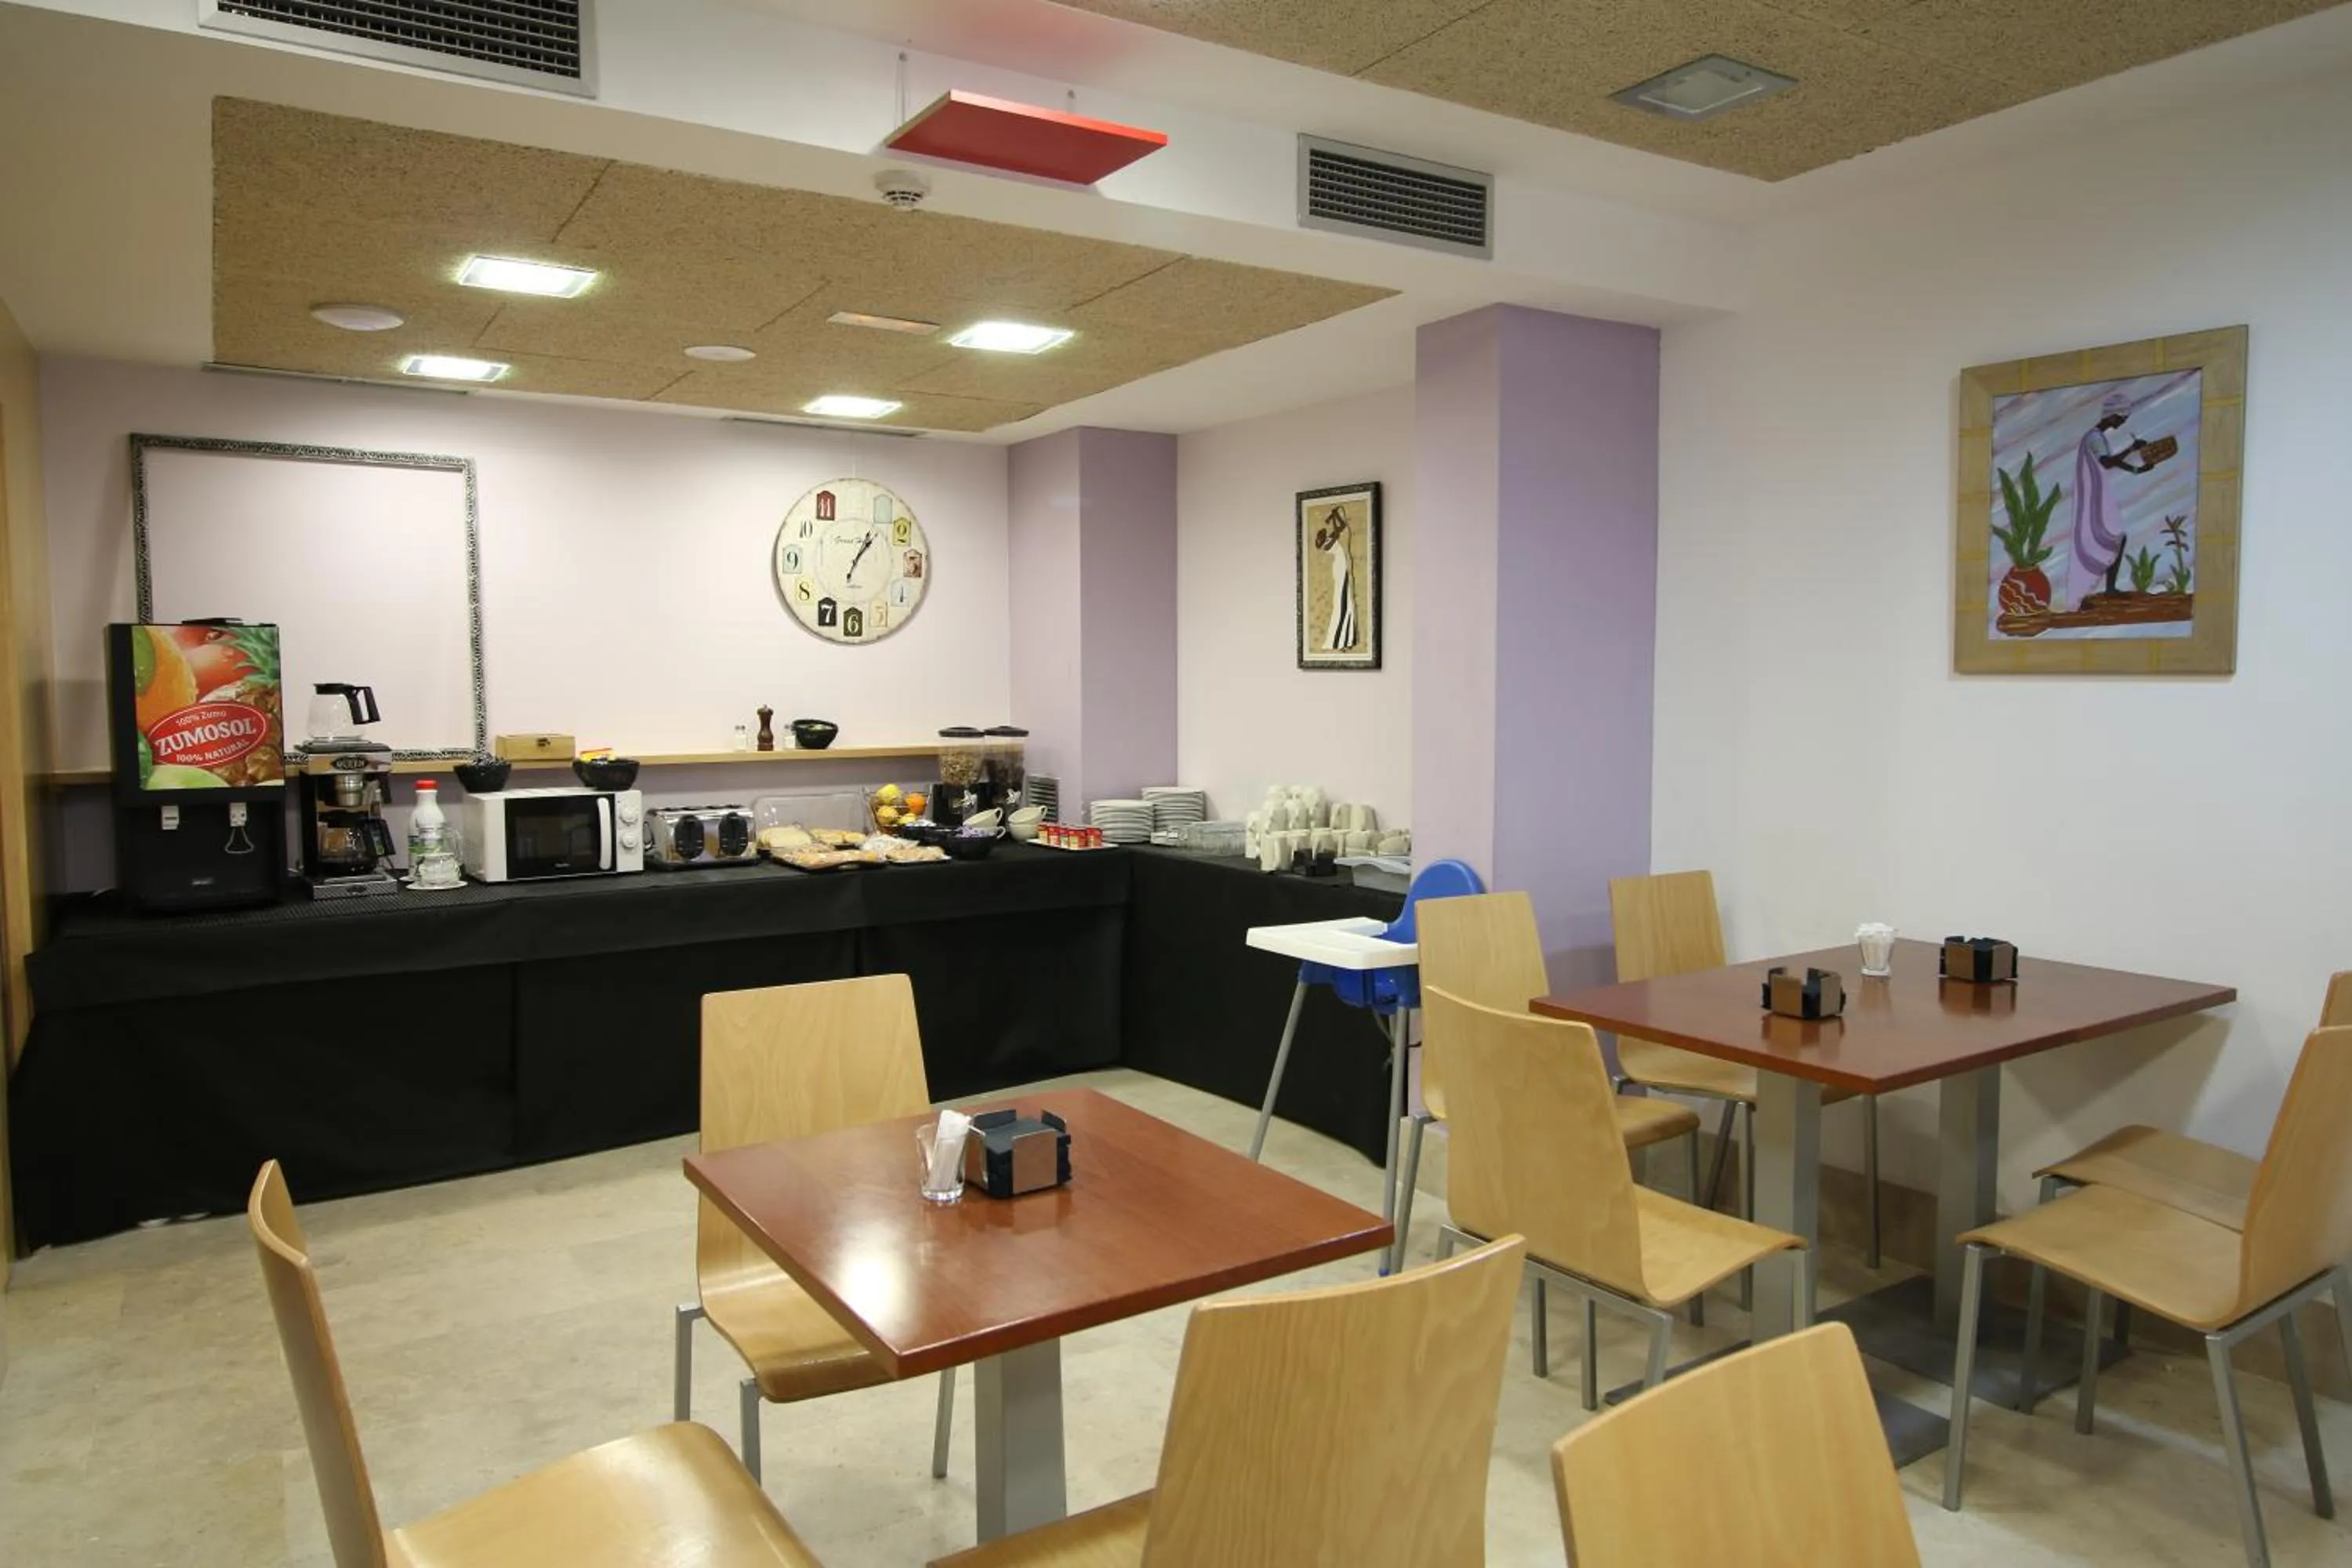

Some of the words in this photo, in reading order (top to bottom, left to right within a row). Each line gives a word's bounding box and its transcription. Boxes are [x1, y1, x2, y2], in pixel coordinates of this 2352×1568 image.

[818, 498, 831, 517] 11
[798, 520, 813, 539] 10
[786, 551, 799, 571] 9
[798, 582, 811, 601] 8
[821, 604, 833, 624] 7
[847, 614, 859, 634] 6
[154, 717, 256, 757] ZUMOSOL
[176, 753, 203, 762] 100%
[205, 739, 250, 760] NATURAL
